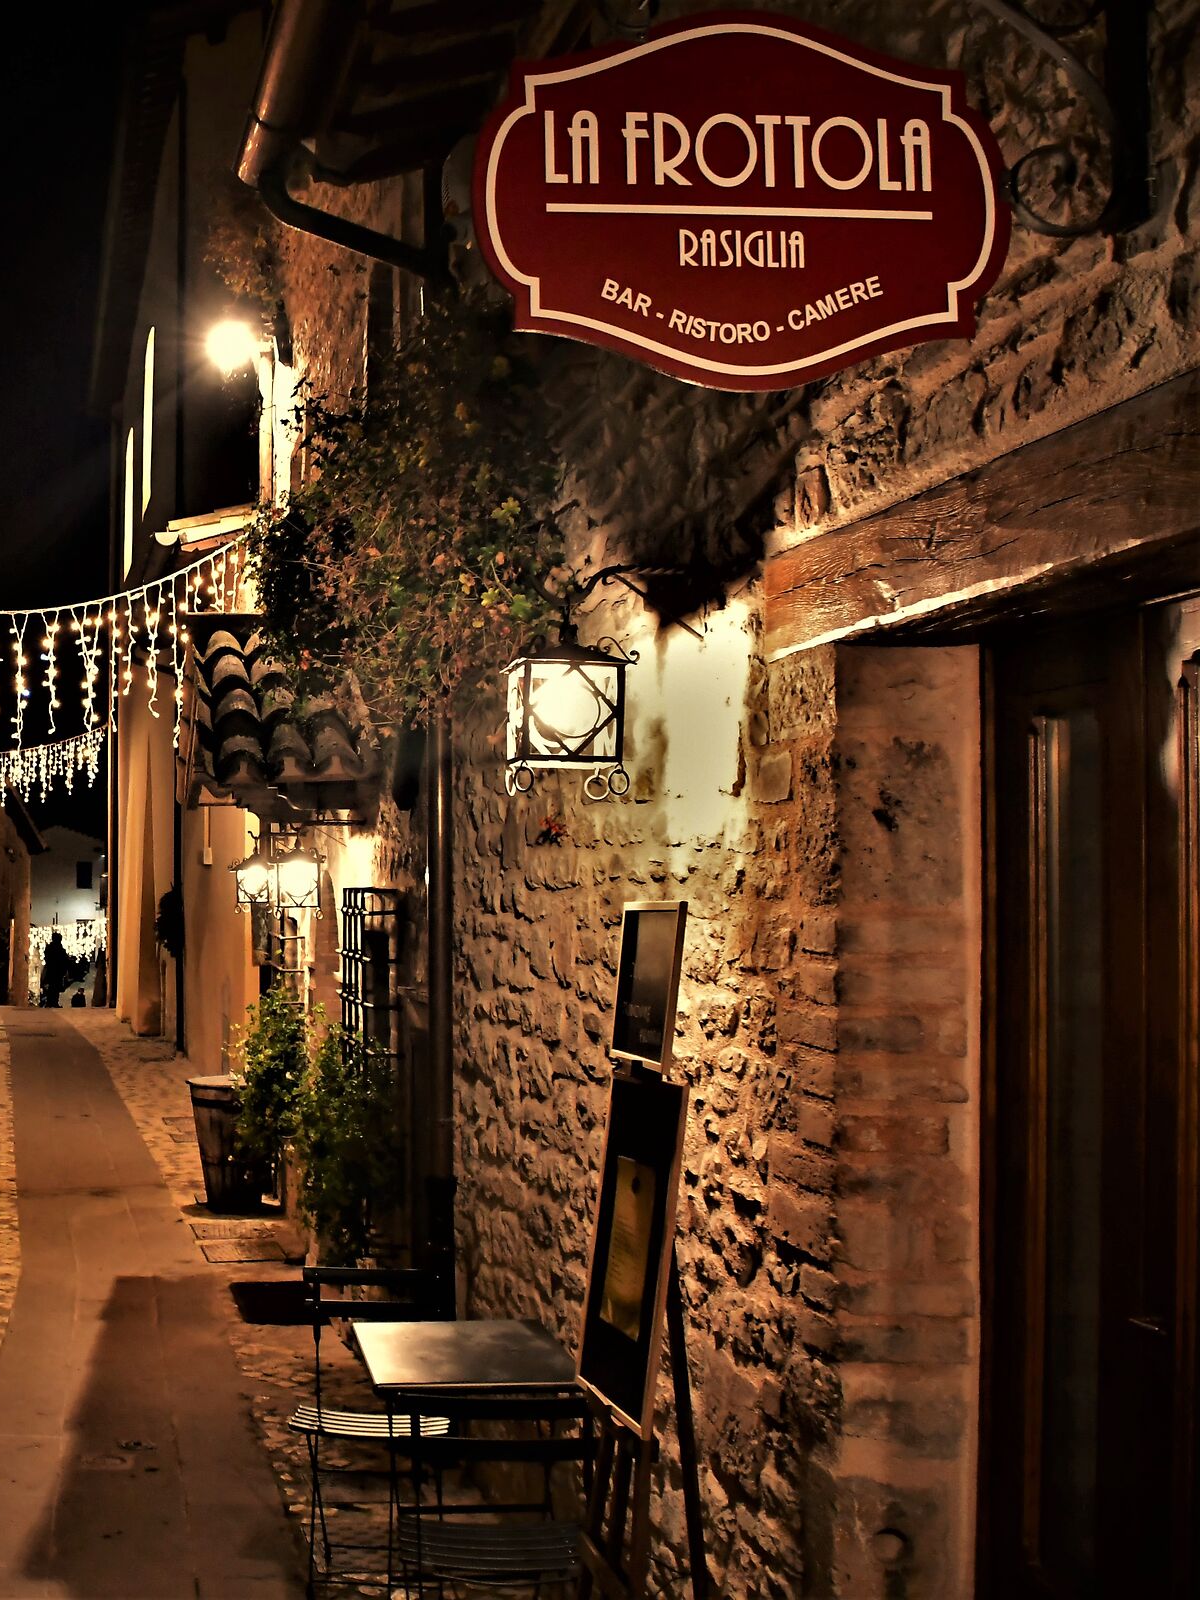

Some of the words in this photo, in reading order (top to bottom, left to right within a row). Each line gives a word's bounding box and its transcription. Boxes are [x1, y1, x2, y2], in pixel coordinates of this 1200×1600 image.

[545, 110, 599, 184] LA
[622, 112, 932, 192] FROTTOLA
[679, 229, 805, 268] RASIGLIA
[601, 278, 652, 317] BAR
[668, 308, 771, 344] RISTORO
[787, 275, 884, 331] CAMERE
